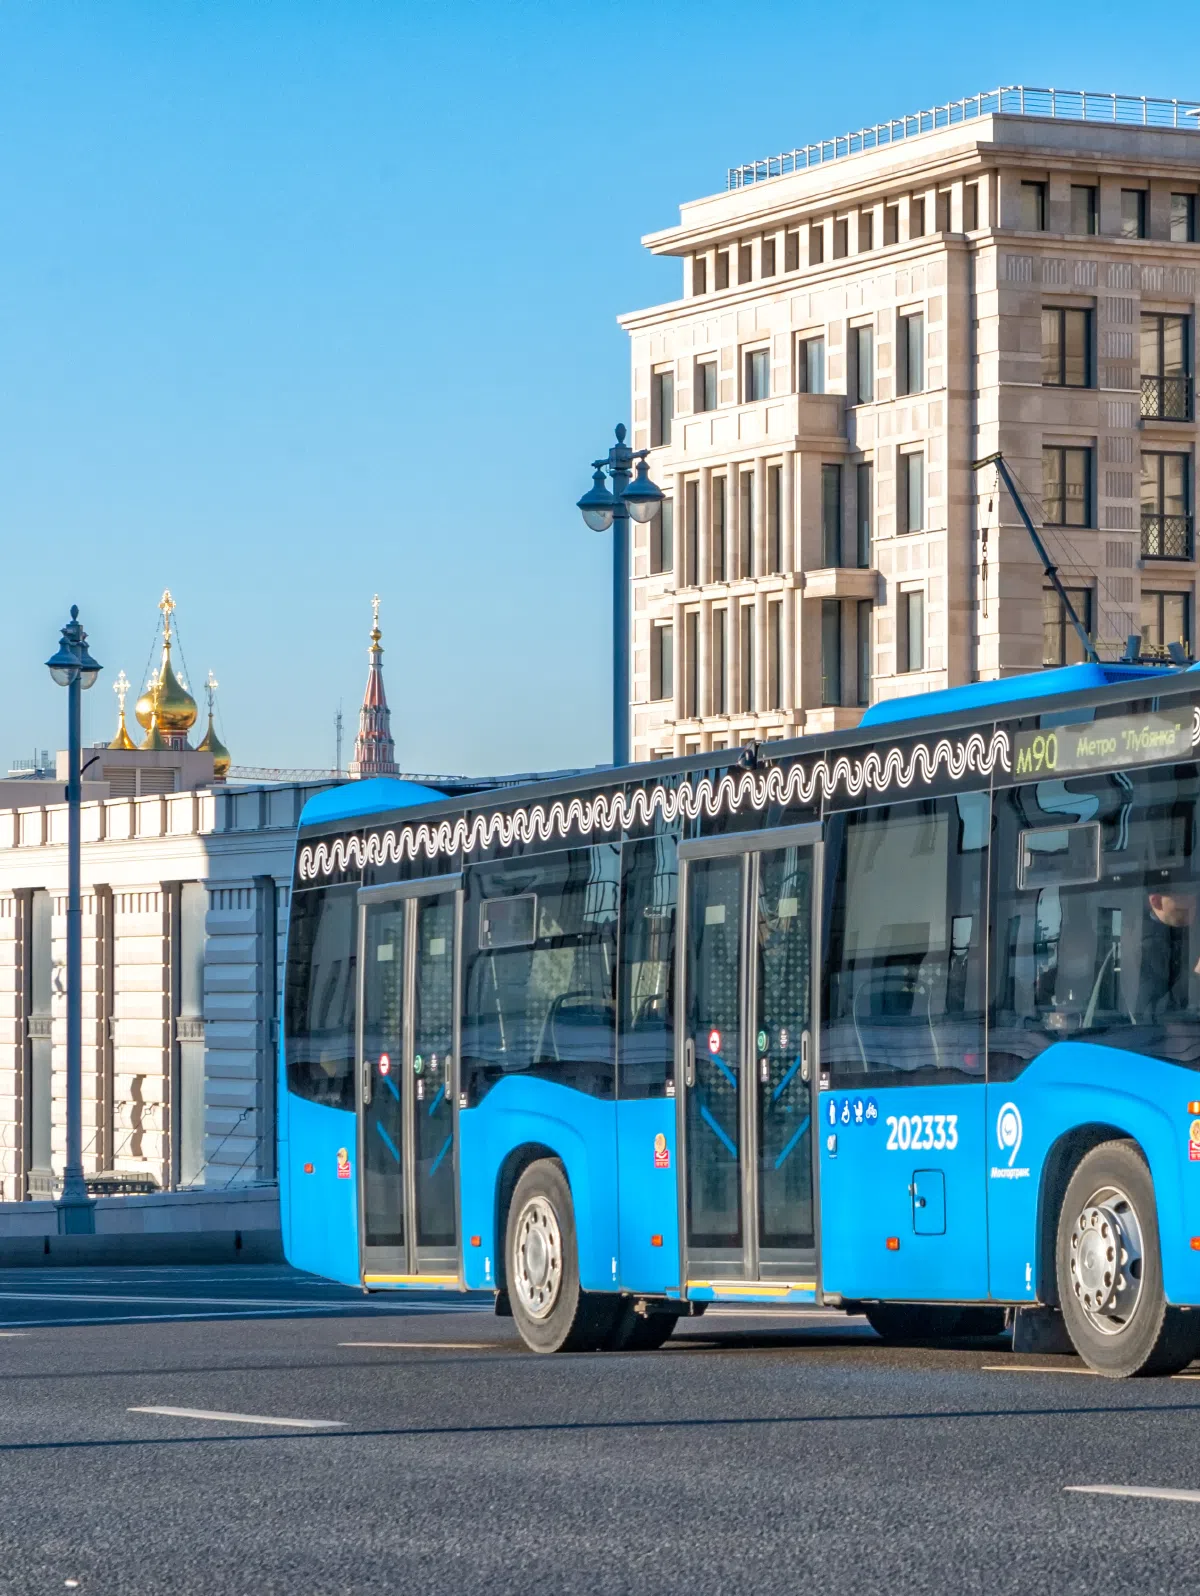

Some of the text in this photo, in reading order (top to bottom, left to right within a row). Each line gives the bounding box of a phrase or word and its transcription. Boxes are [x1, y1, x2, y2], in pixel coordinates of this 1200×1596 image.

[1076, 737, 1117, 757] Метро
[1122, 724, 1181, 751] "Лубянка"
[886, 1115, 958, 1150] 202333
